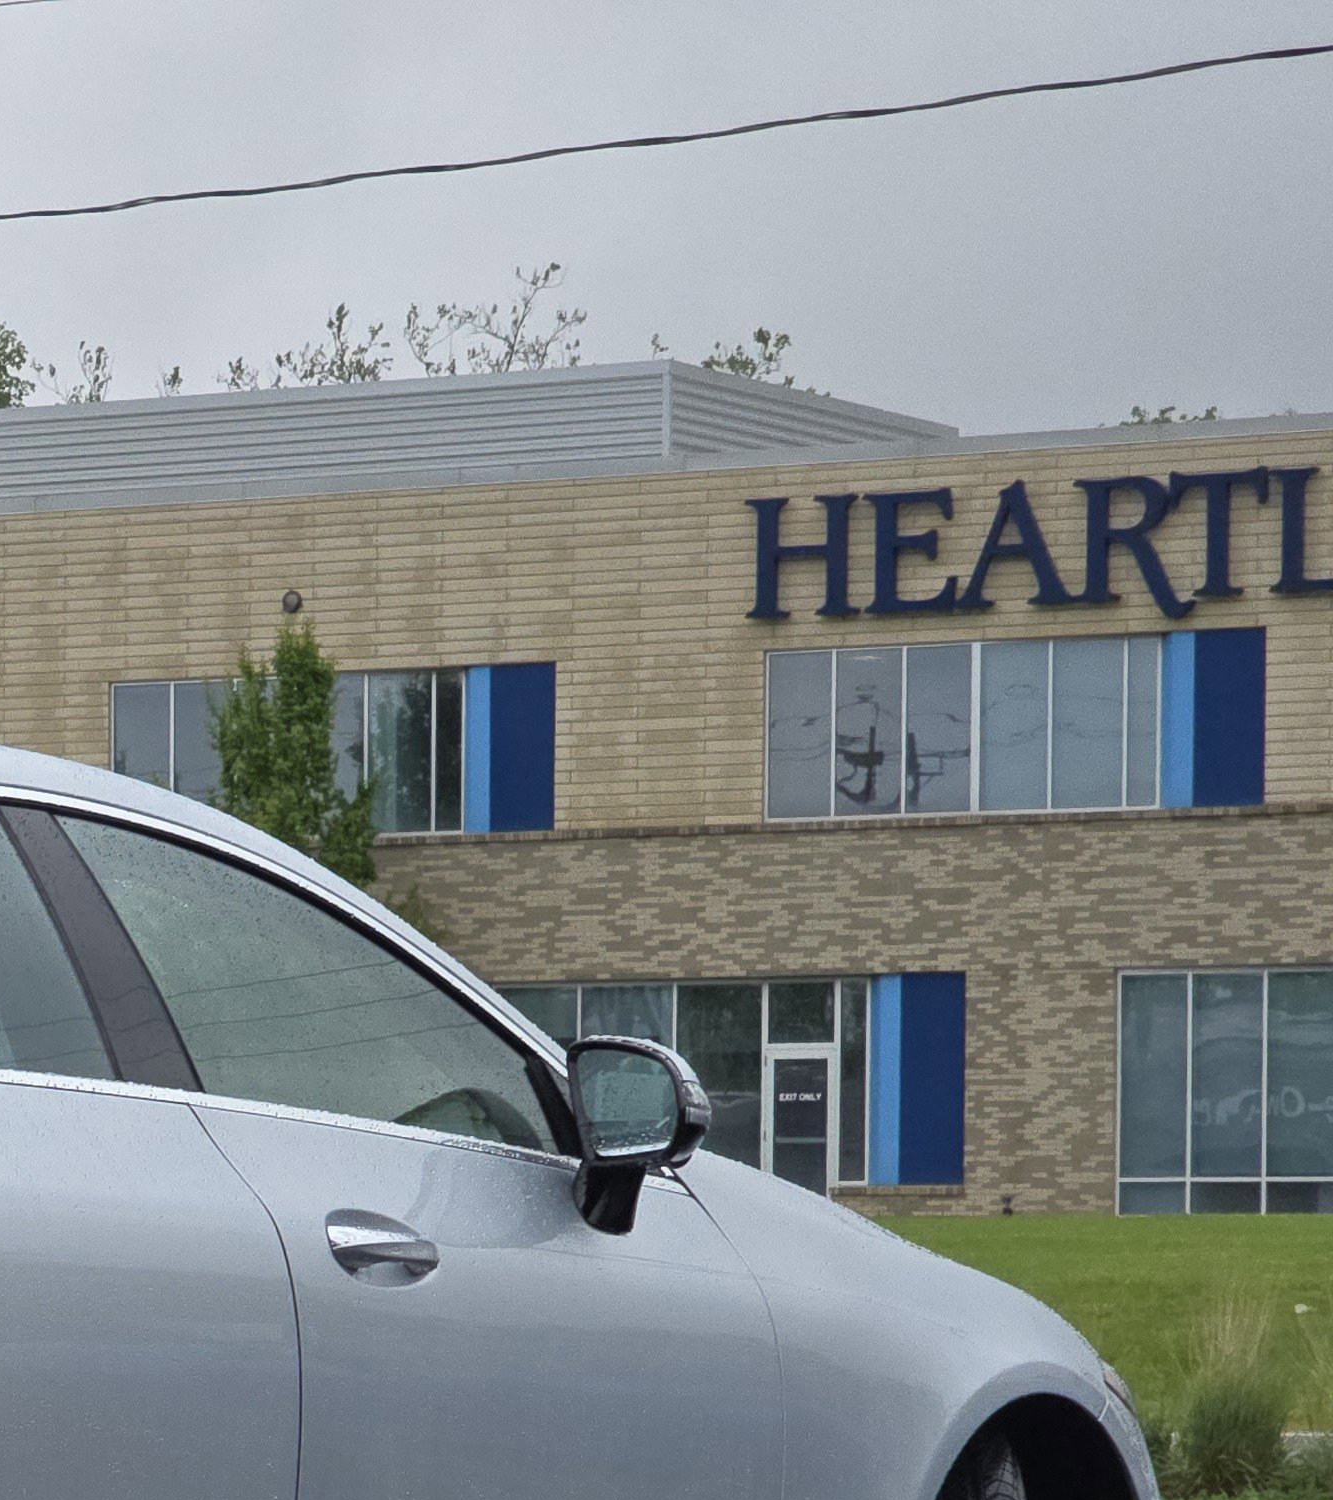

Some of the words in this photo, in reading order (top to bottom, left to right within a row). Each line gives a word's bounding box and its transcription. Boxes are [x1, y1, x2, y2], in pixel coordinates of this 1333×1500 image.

[744, 466, 1333, 619] HEARTL
[779, 1093, 797, 1101] EXIT
[799, 1093, 822, 1101] ONLY
